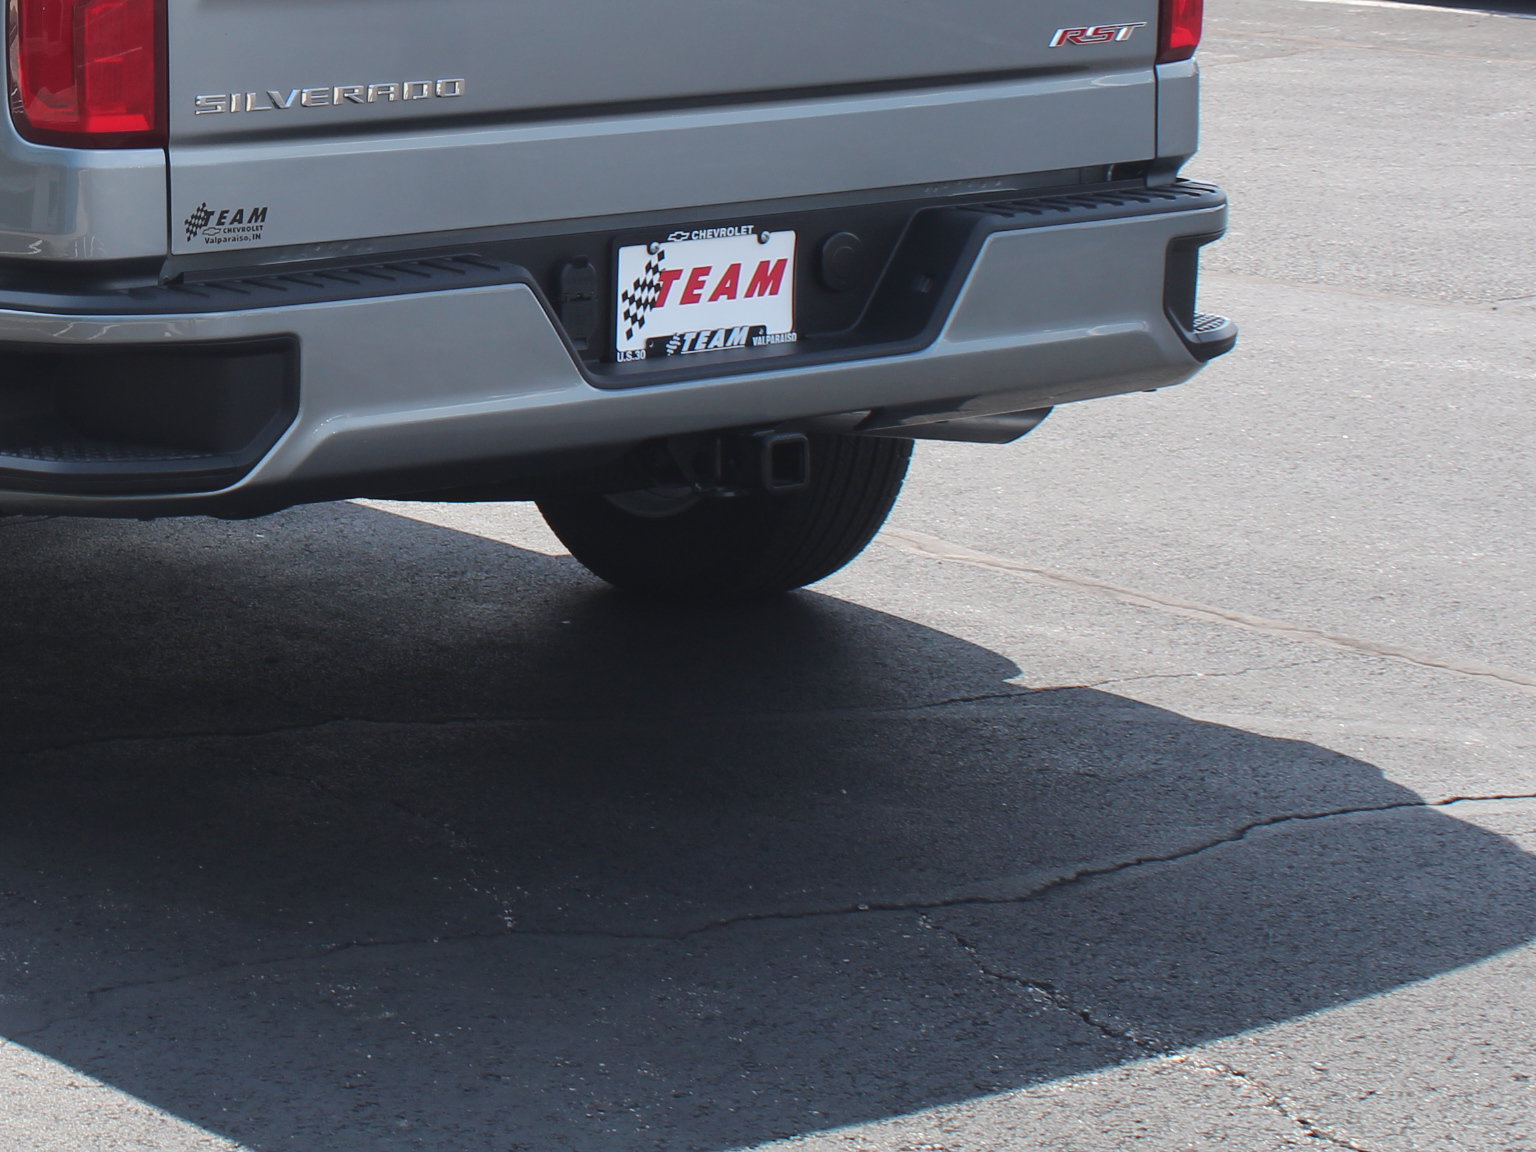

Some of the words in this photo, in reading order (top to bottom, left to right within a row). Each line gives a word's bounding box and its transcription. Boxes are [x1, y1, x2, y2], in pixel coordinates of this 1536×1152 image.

[1049, 21, 1148, 47] RST
[194, 78, 465, 115] SILVERADO
[202, 207, 268, 226] TEAM
[223, 225, 264, 234] CHEVROLET
[252, 233, 262, 241] IN
[691, 225, 755, 240] CHEVROLET
[655, 258, 789, 308] TEAM
[681, 326, 751, 353] TEAM
[752, 332, 798, 347] VALPARAISO
